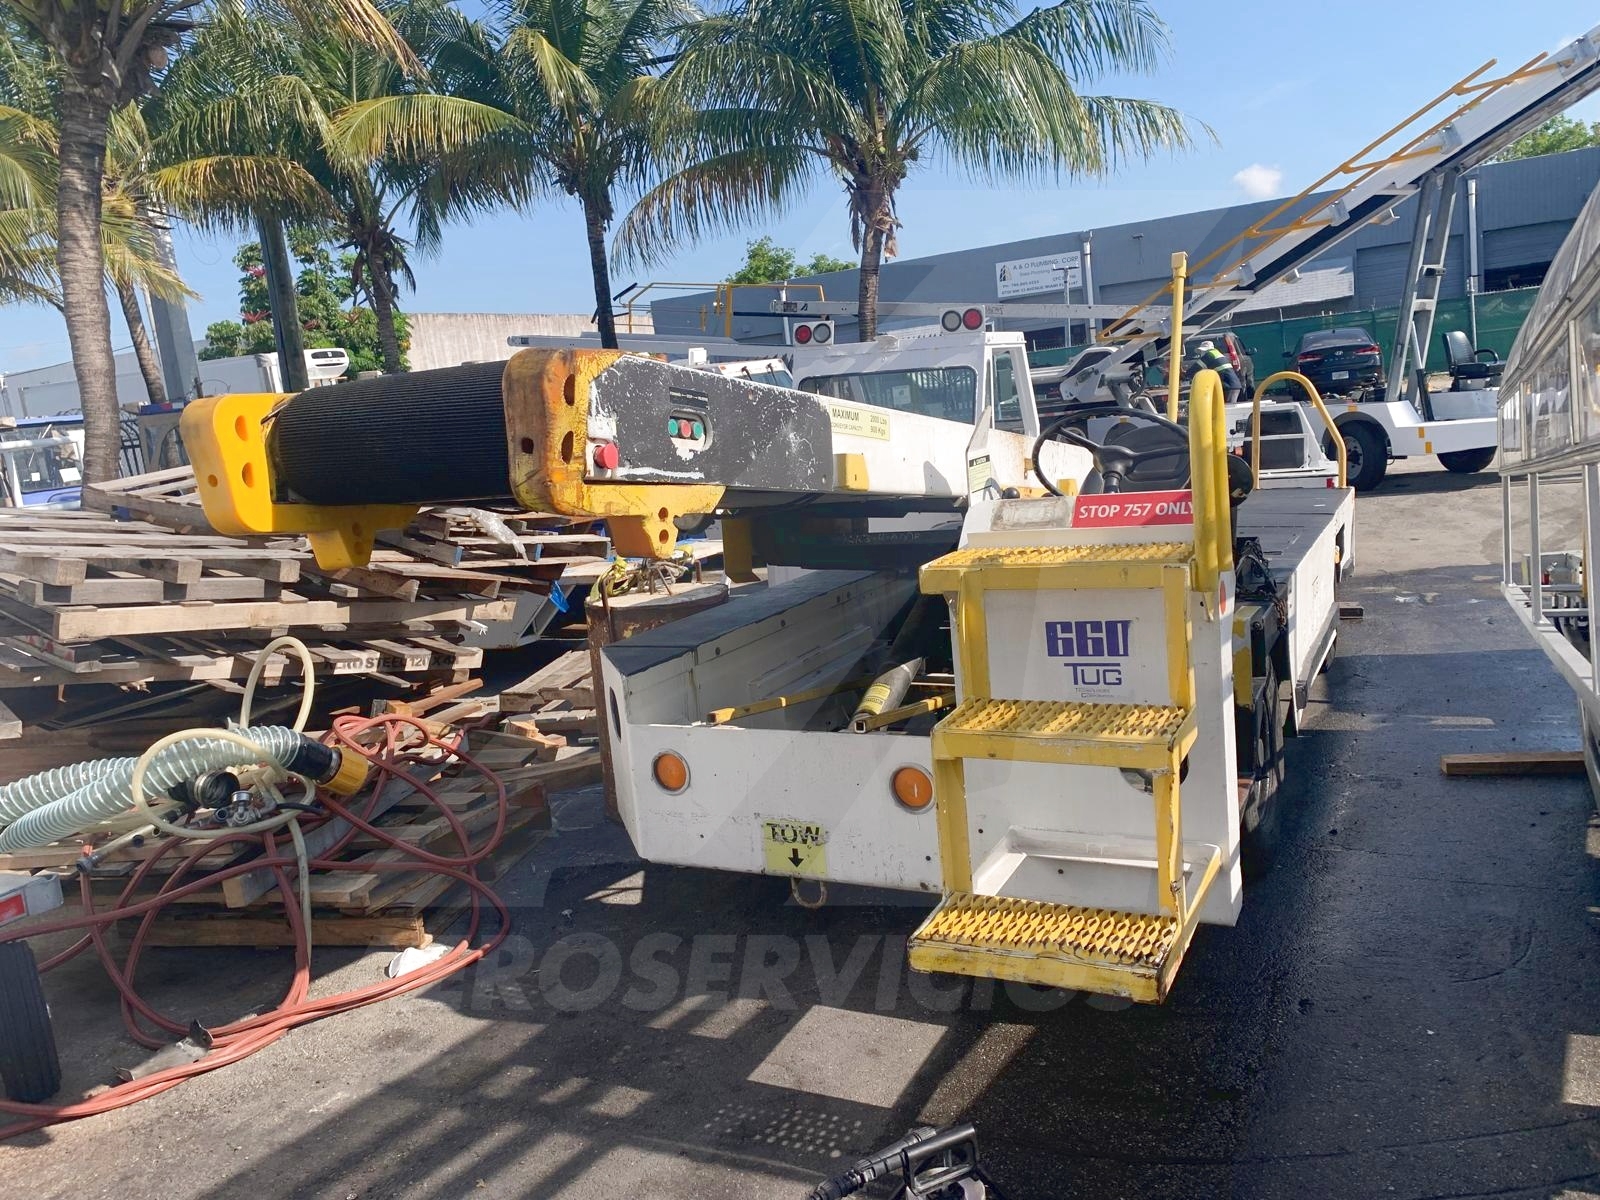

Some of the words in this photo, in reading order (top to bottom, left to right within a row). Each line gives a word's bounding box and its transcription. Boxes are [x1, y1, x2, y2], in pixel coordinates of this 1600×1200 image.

[832, 408, 859, 422] MAXIMUM
[1079, 505, 1120, 518] STOP
[1124, 504, 1152, 517] 757
[1045, 620, 1132, 657] 660
[1064, 662, 1122, 685] TUG
[766, 822, 820, 844] TOW
